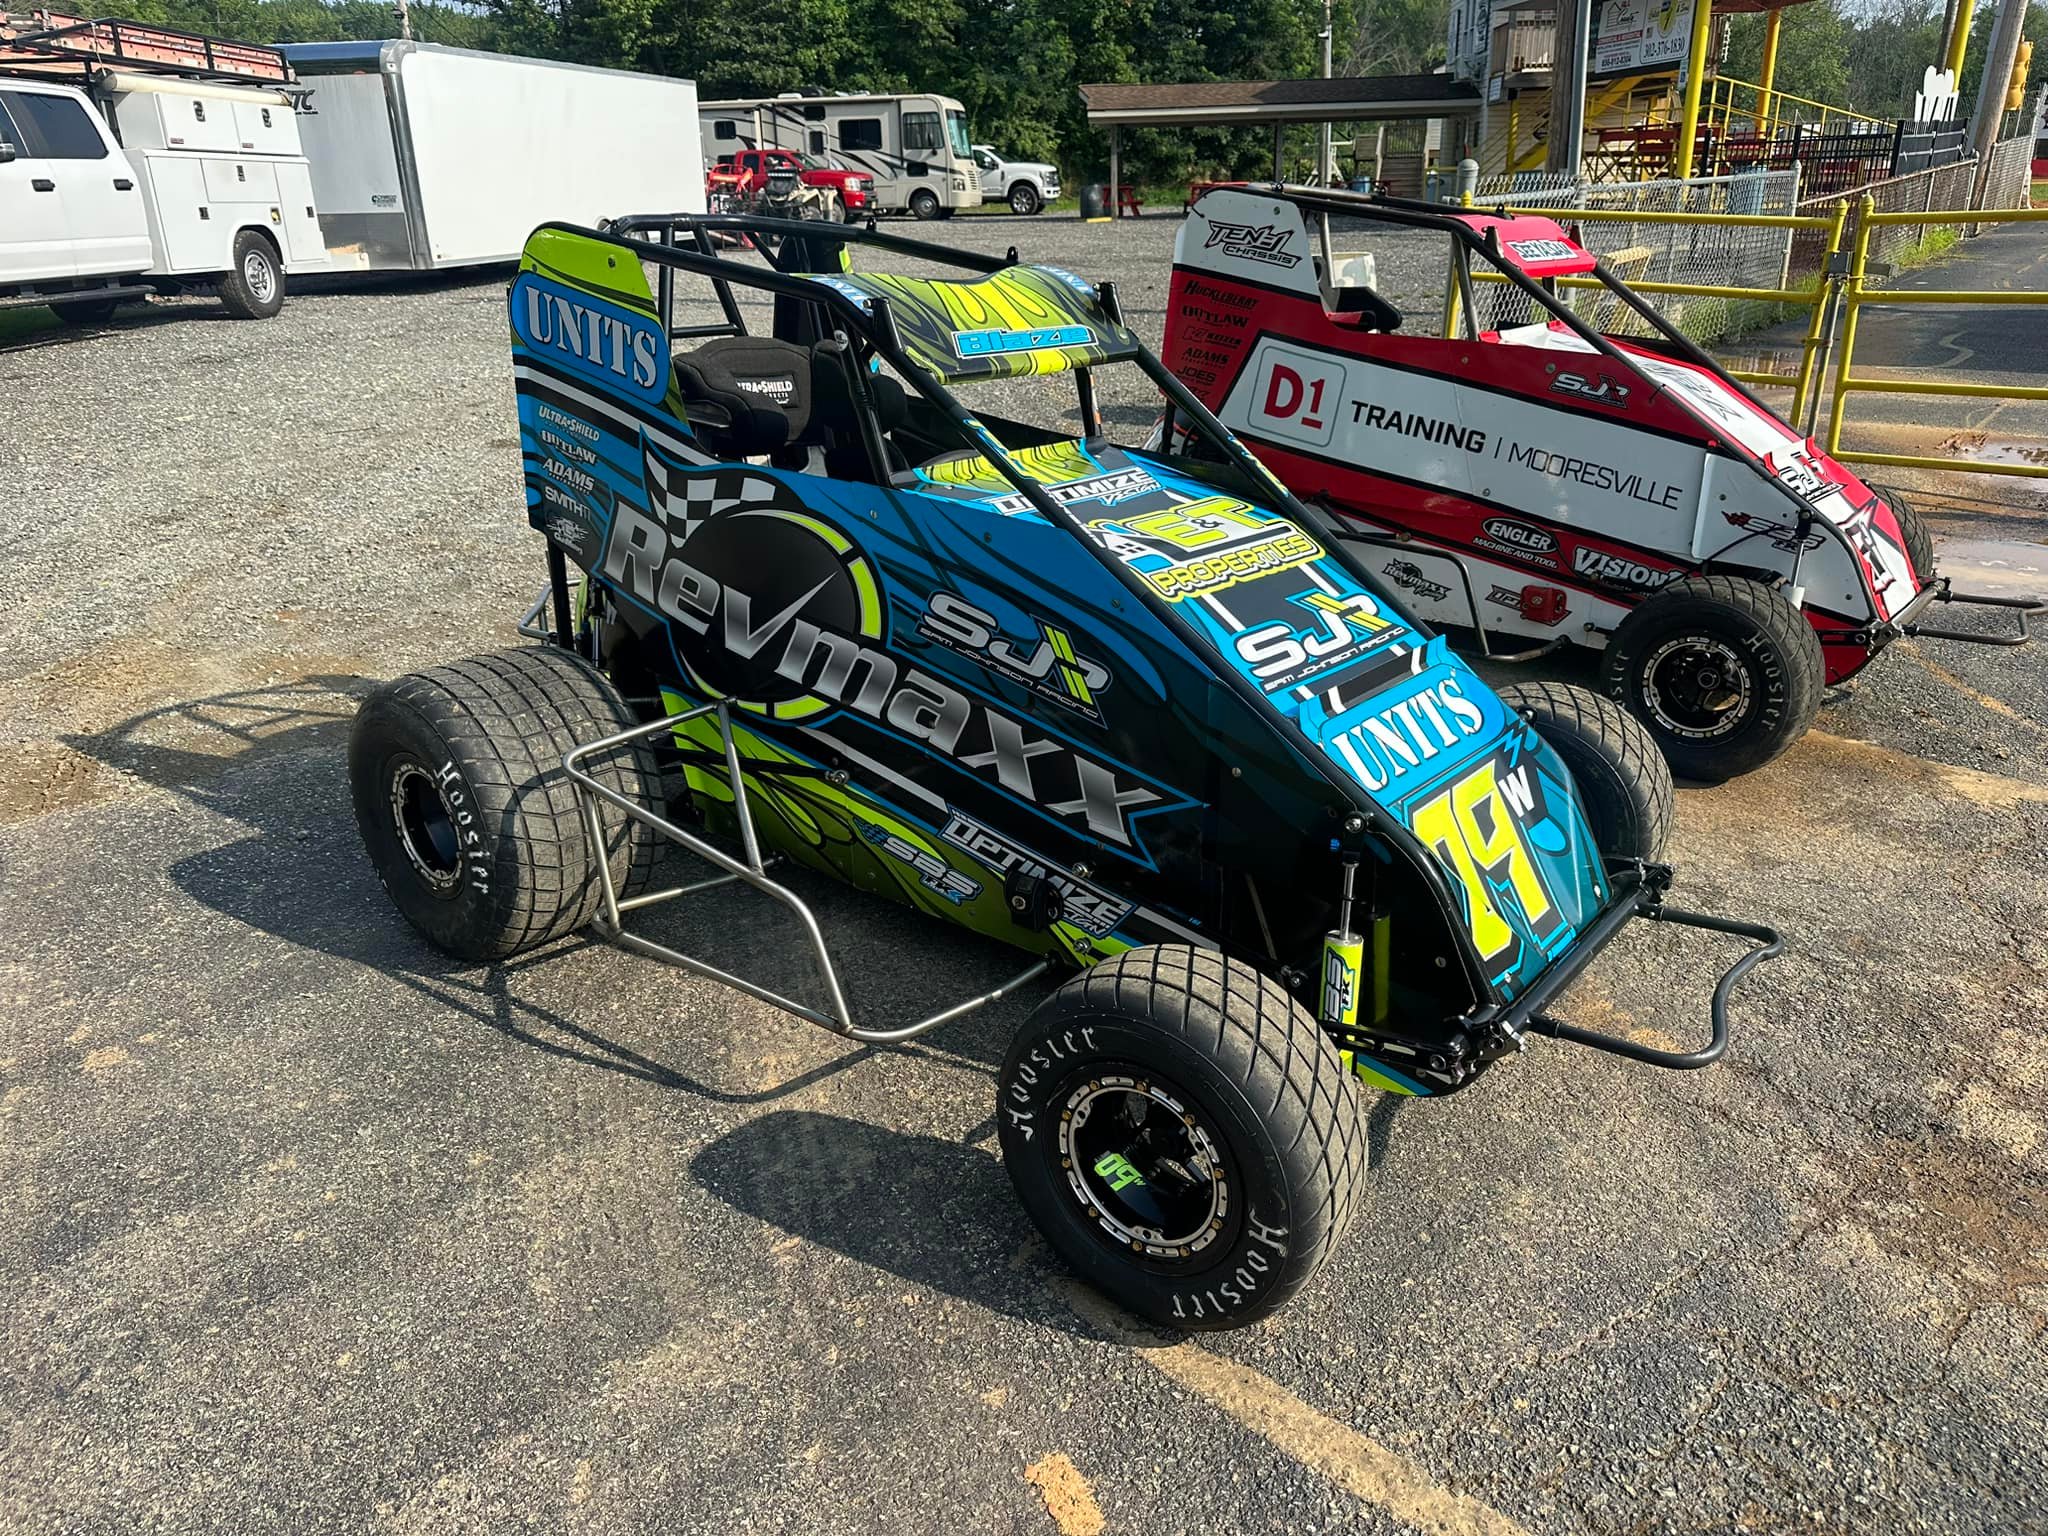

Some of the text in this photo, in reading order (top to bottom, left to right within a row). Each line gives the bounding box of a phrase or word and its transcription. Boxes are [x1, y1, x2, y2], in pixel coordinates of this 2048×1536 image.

[1224, 244, 1294, 265] CHASSIS
[1182, 305, 1249, 328] OUTLAW
[1184, 279, 1260, 309] HUCKLEBERRY
[525, 285, 657, 389] UNITS
[1184, 347, 1230, 365] ADAMS
[1177, 365, 1217, 383] JOES
[1263, 363, 1327, 430] D1
[541, 430, 597, 465] OUTLAW
[1351, 400, 1684, 511] TRAINING MOORESVILLE
[542, 458, 595, 491] ADAMS
[1472, 536, 1558, 569] MACHINE AND TOOL
[1488, 521, 1552, 551] ENGLER
[1149, 533, 1315, 592] PROPERTIES
[918, 627, 1100, 719] SAM JOHNSON RACING
[1263, 626, 1405, 692] SAM JOHNSON RACING
[1331, 678, 1484, 792] UNITS
[434, 761, 490, 895] Hoosier
[1005, 1025, 1099, 1142] Hoosier
[1094, 1153, 1143, 1192] 09
[1171, 1206, 1291, 1321] Hoosier
